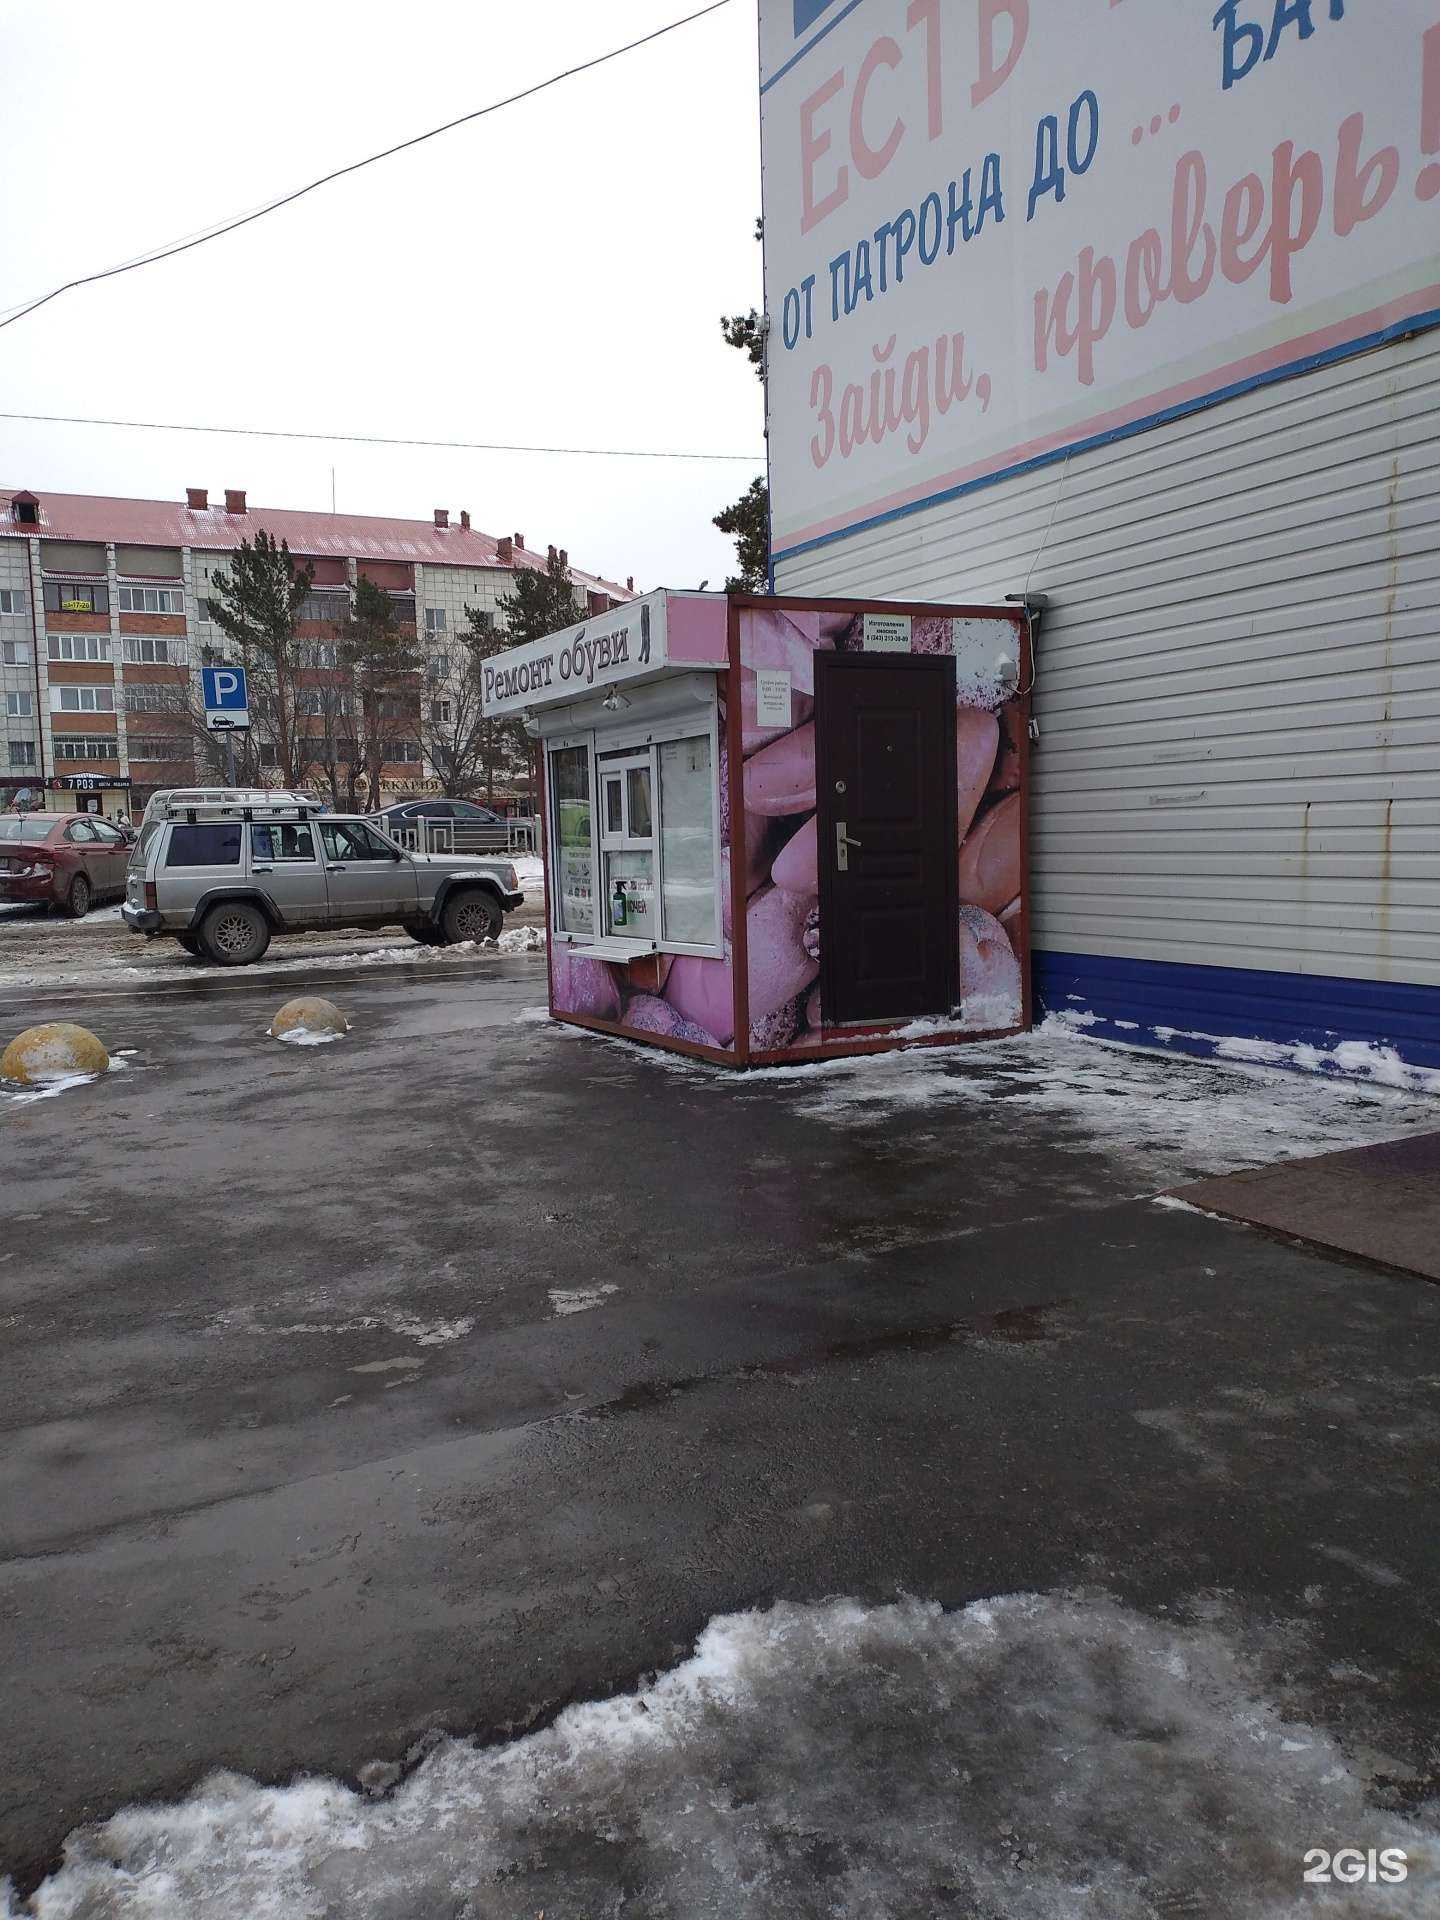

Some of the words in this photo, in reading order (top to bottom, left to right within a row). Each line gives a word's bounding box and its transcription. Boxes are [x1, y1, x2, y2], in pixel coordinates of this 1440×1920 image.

[783, 274, 816, 350] ОТ
[829, 153, 1005, 321] ПАТРОНА
[1026, 89, 1099, 222] ДО
[1212, 0, 1345, 90] БА
[801, 0, 1030, 236] ЕСТЬ
[810, 331, 992, 469] Зайди,
[1034, 22, 1440, 386] проверь!
[214, 672, 238, 704] P
[484, 654, 554, 704] Ремонт
[559, 627, 630, 685] обуви
[68, 779, 74, 790] 7
[76, 779, 94, 790] РОЗ
